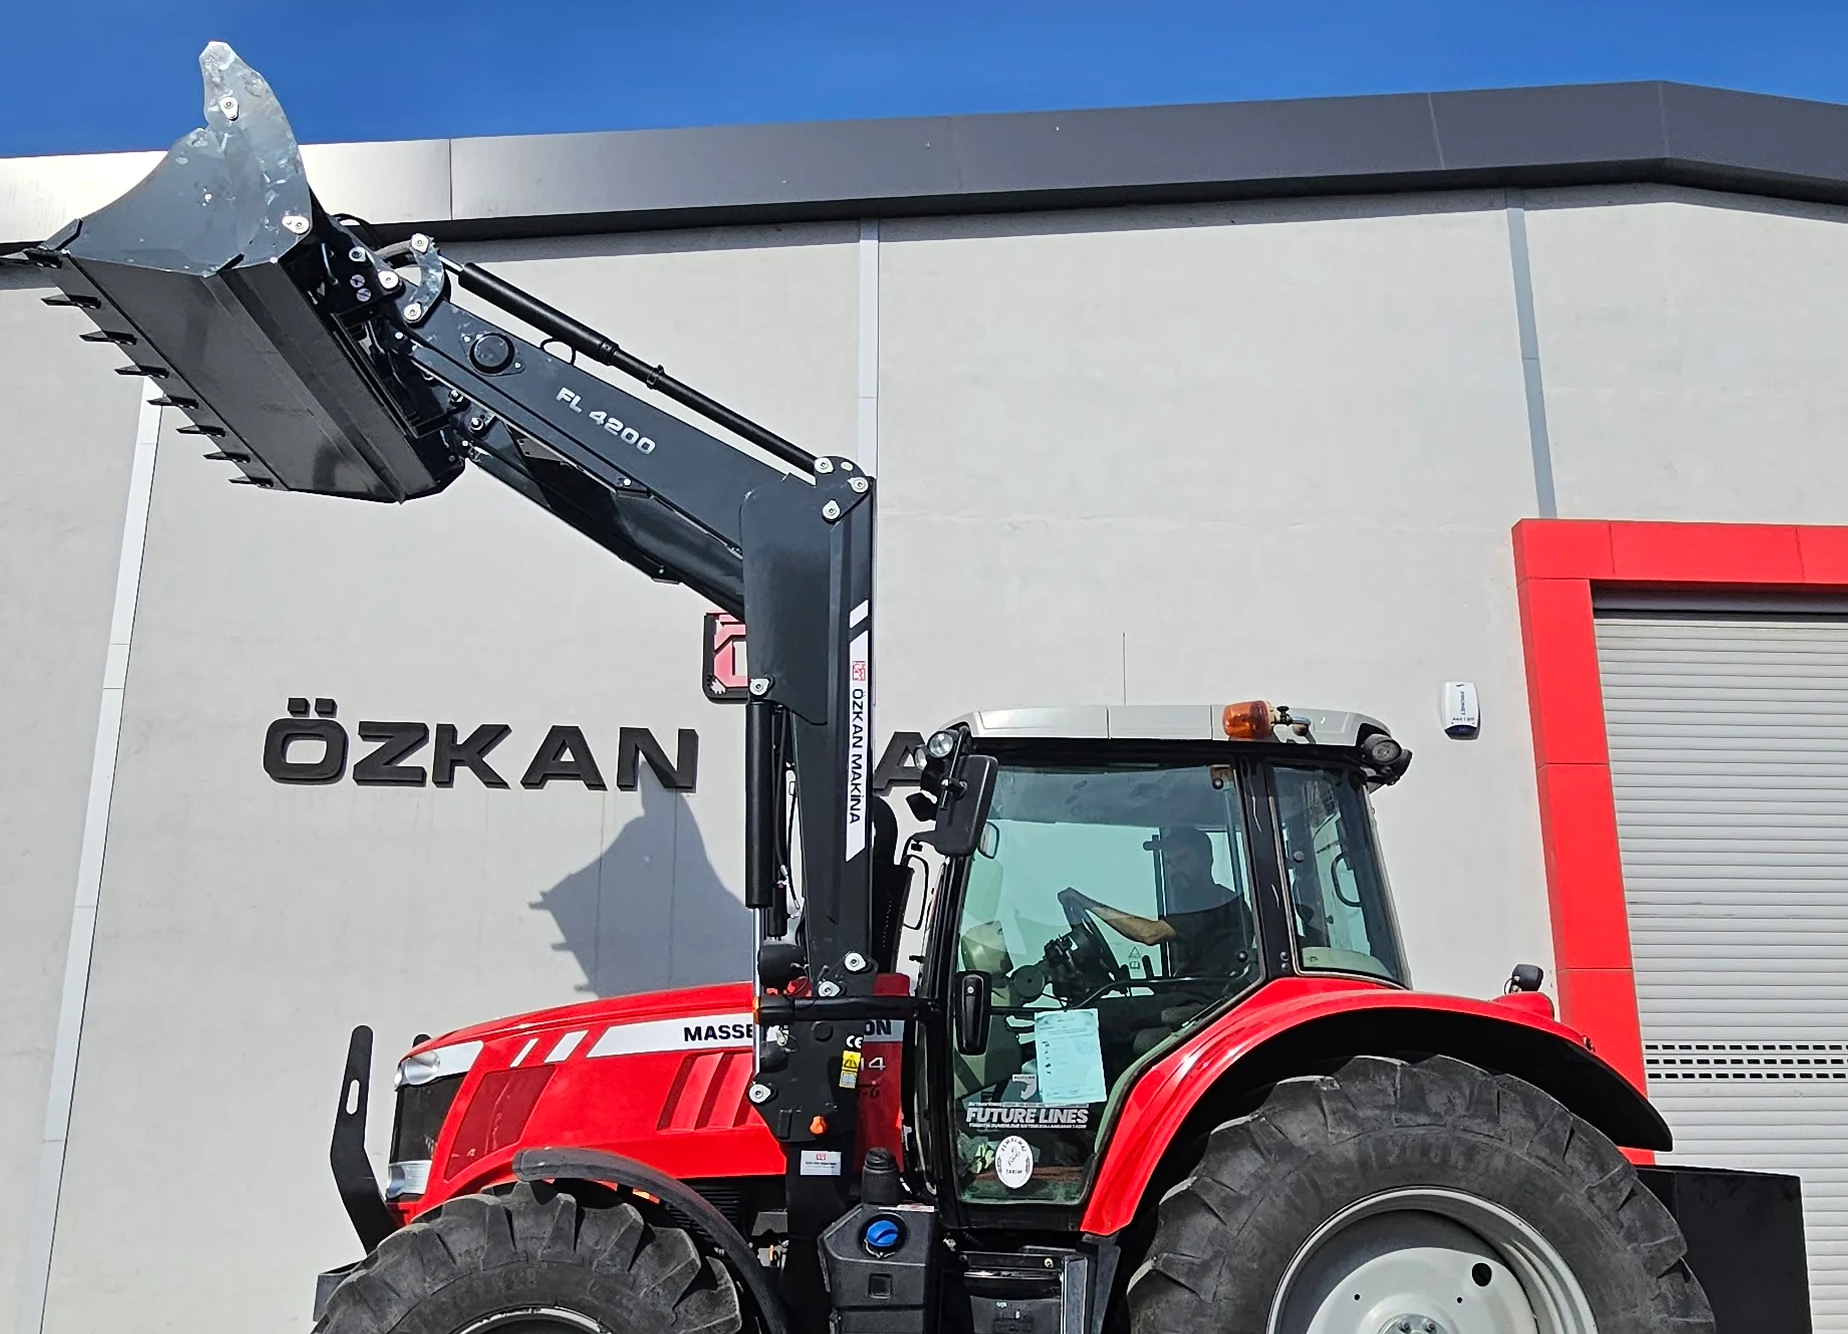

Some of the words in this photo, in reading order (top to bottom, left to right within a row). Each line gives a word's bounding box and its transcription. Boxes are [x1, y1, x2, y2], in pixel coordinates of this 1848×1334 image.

[556, 387, 583, 413] FL
[588, 410, 656, 455] 4200
[263, 697, 699, 793] ÖZKAN
[851, 688, 866, 749] ÖZKAN
[849, 754, 865, 824] MAKİNA
[683, 1023, 753, 1042] MASSE
[966, 1107, 1037, 1123] FUTURE
[1038, 1108, 1089, 1124] LINES
